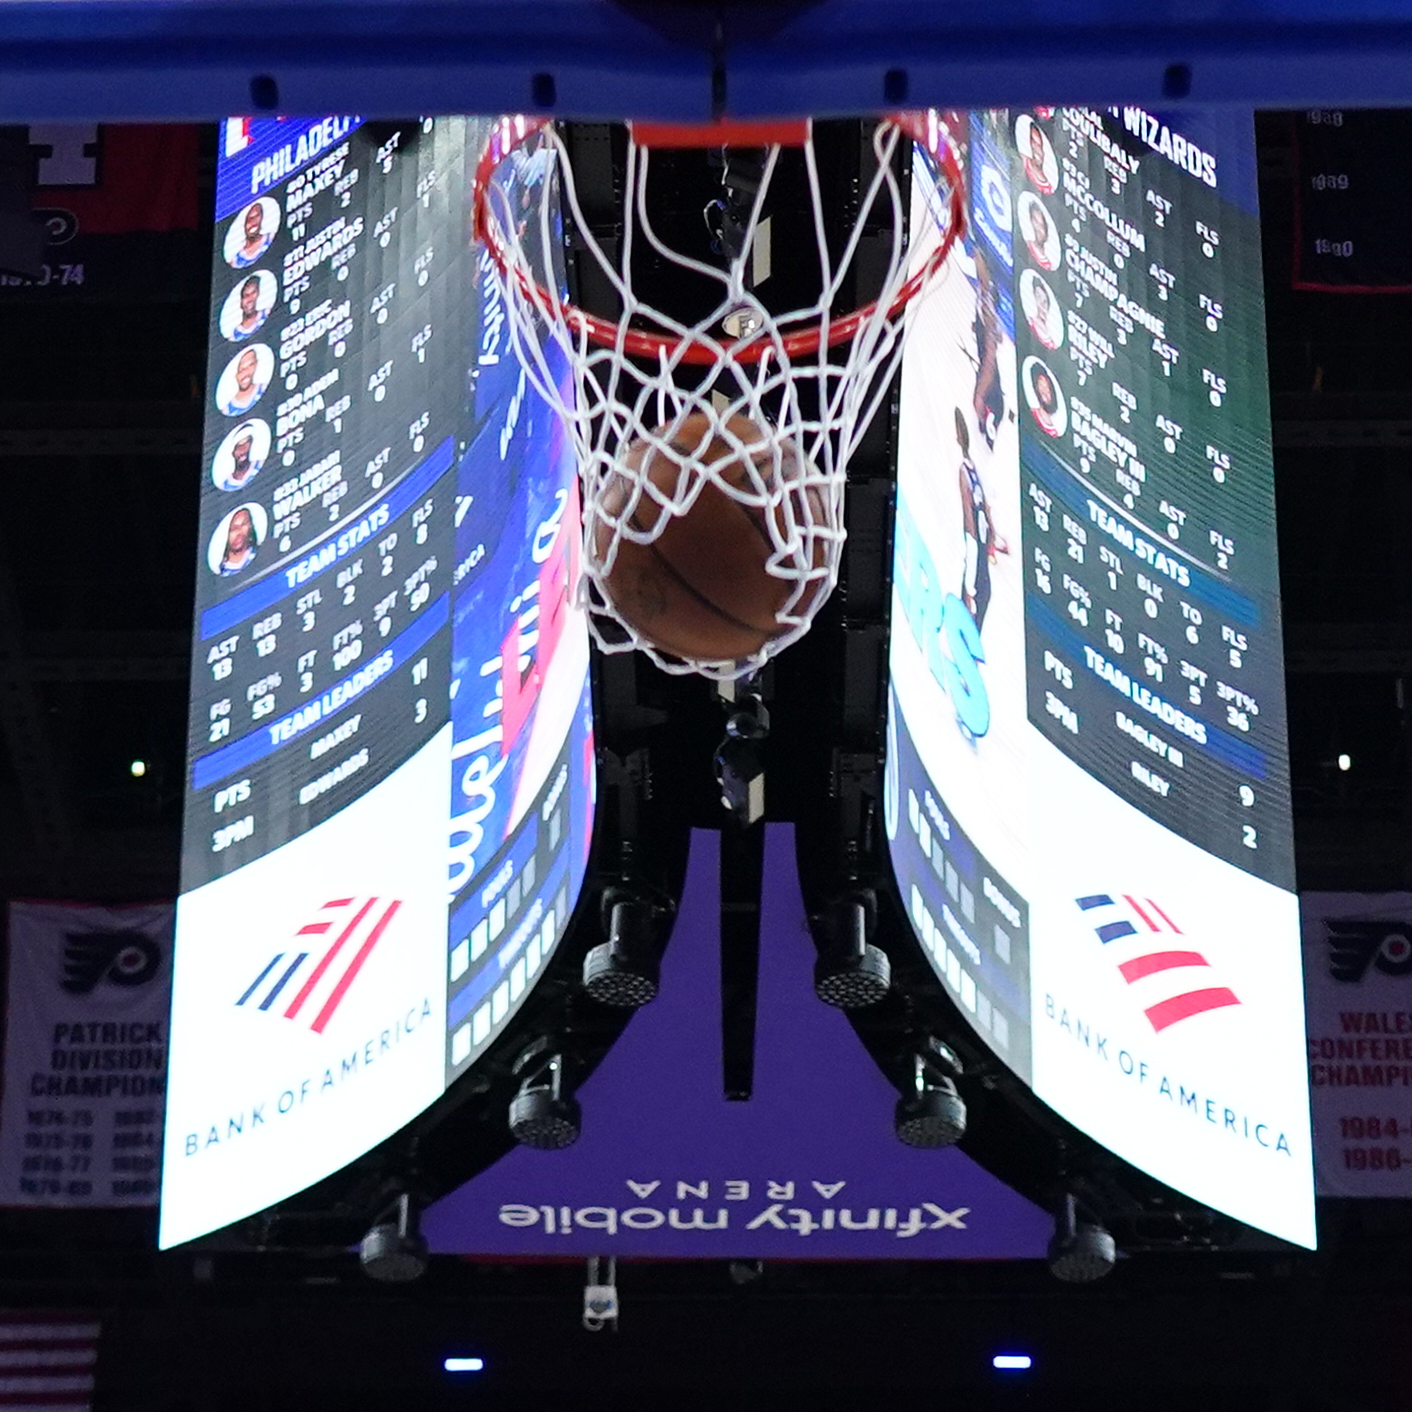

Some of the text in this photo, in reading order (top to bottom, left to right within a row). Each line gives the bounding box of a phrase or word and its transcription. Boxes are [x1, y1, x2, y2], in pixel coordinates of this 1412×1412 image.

[1063, 107, 1141, 176] COULIBALY
[1123, 107, 1218, 189] WIZARDS
[286, 160, 345, 210] MAXEY
[1063, 171, 1146, 252] MCCOLLUM
[282, 217, 364, 286] EDWARDS
[279, 301, 351, 360] GORDON
[1065, 249, 1166, 340] CHAMPAGNIE
[275, 395, 326, 436] BONA
[1071, 415, 1129, 470] BAGLEY
[272, 465, 343, 521] WALKER
[1029, 482, 1124, 575] AST REB STL
[286, 503, 390, 588] TEAM STATS
[1033, 506, 1117, 590] 13 21 1
[1087, 499, 1191, 588] TEAM STATS
[207, 533, 398, 666] AST REB STL BLK TO
[211, 555, 393, 681] 13 13 3 2 2
[213, 656, 429, 813] PTS MAXEY 11
[268, 650, 394, 745] TEAM LEADERS
[1044, 650, 1074, 690] PTS
[1116, 711, 1169, 758] BAGLEY
[1239, 785, 1255, 807] 9
[1084, 645, 1208, 745] TEAM LEADERS
[212, 748, 370, 852] 3PM EDWARDS
[1045, 690, 1258, 849] 3PM RILEY 2
[50, 1047, 164, 1070] DIVISION
[53, 1022, 163, 1045] PATRICK
[1043, 993, 1295, 1155] BANK OF AMERICA
[184, 1103, 269, 1158] BANK
[278, 1087, 317, 1118] OF
[320, 996, 437, 1087] AMERICA
[498, 1198, 971, 1240] xfinity mobile
[626, 1179, 846, 1198] ARENA
